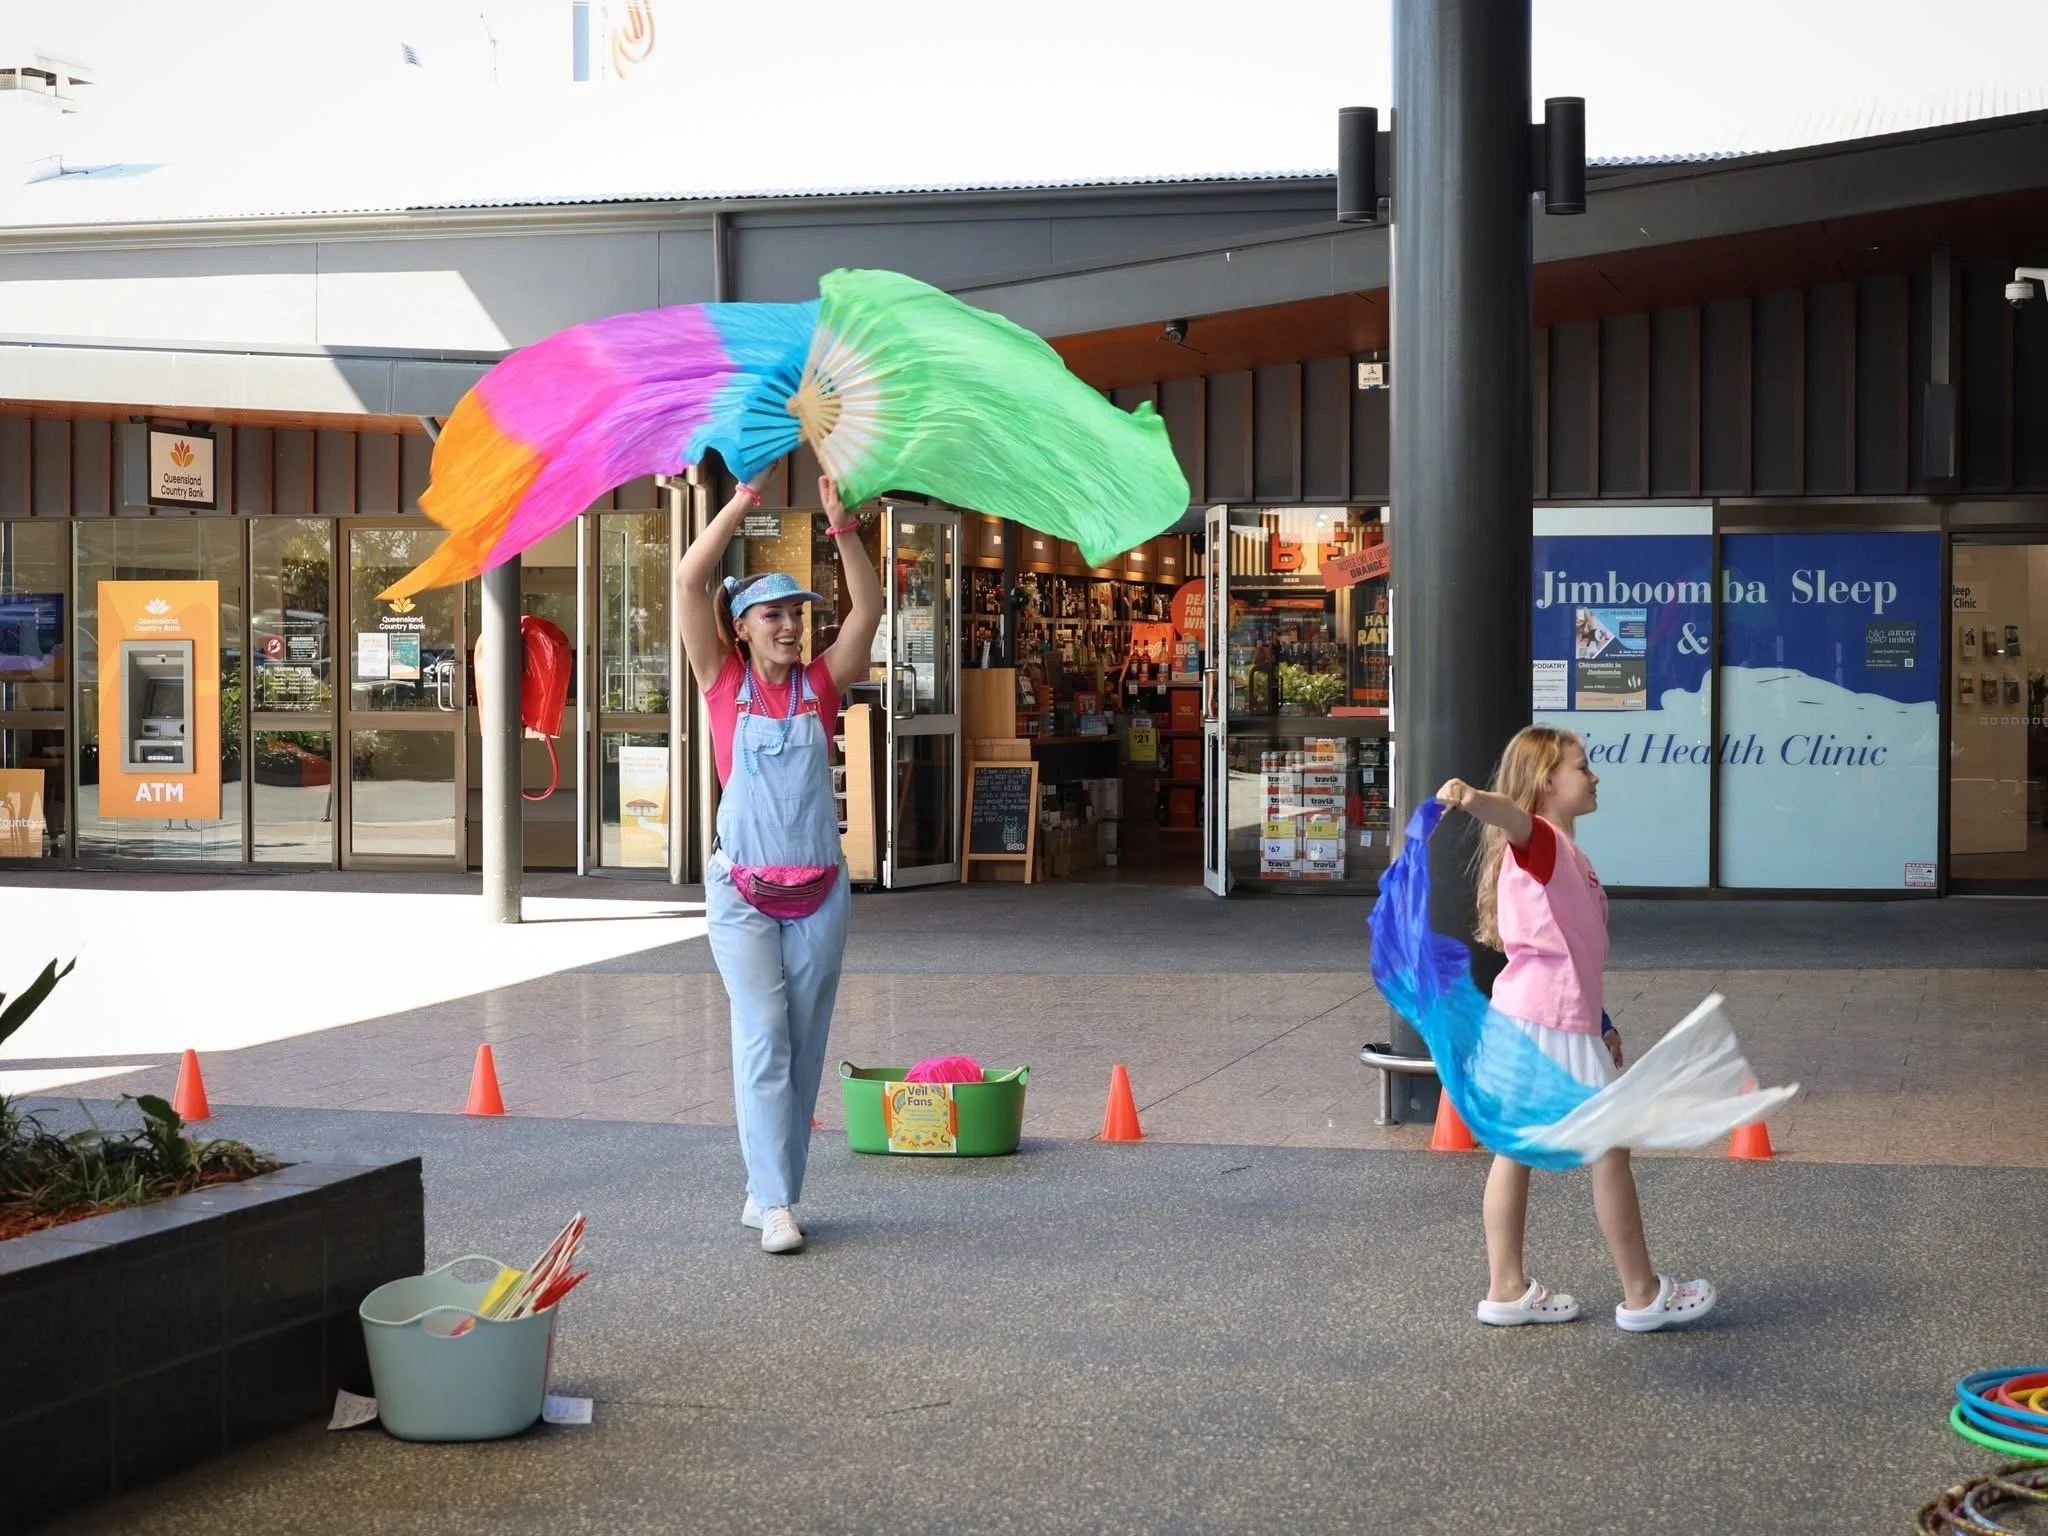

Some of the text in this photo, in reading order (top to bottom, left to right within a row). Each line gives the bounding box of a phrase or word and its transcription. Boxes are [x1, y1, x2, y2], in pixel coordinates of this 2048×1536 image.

[163, 473, 202, 486] Queensland
[161, 485, 205, 499] Country Bank
[1536, 569, 1897, 614] Jimboomba Sleep
[1954, 598, 1976, 608] Clinic
[1185, 606, 1203, 616] FOR
[379, 623, 407, 631] Country
[1677, 622, 1710, 655] &
[1175, 643, 1196, 656] BIG
[1637, 733, 1765, 766] Health
[1780, 734, 1888, 766] Clinic
[135, 783, 184, 802] ATM
[907, 1086, 928, 1096] Veil
[907, 1097, 933, 1106] Fans
